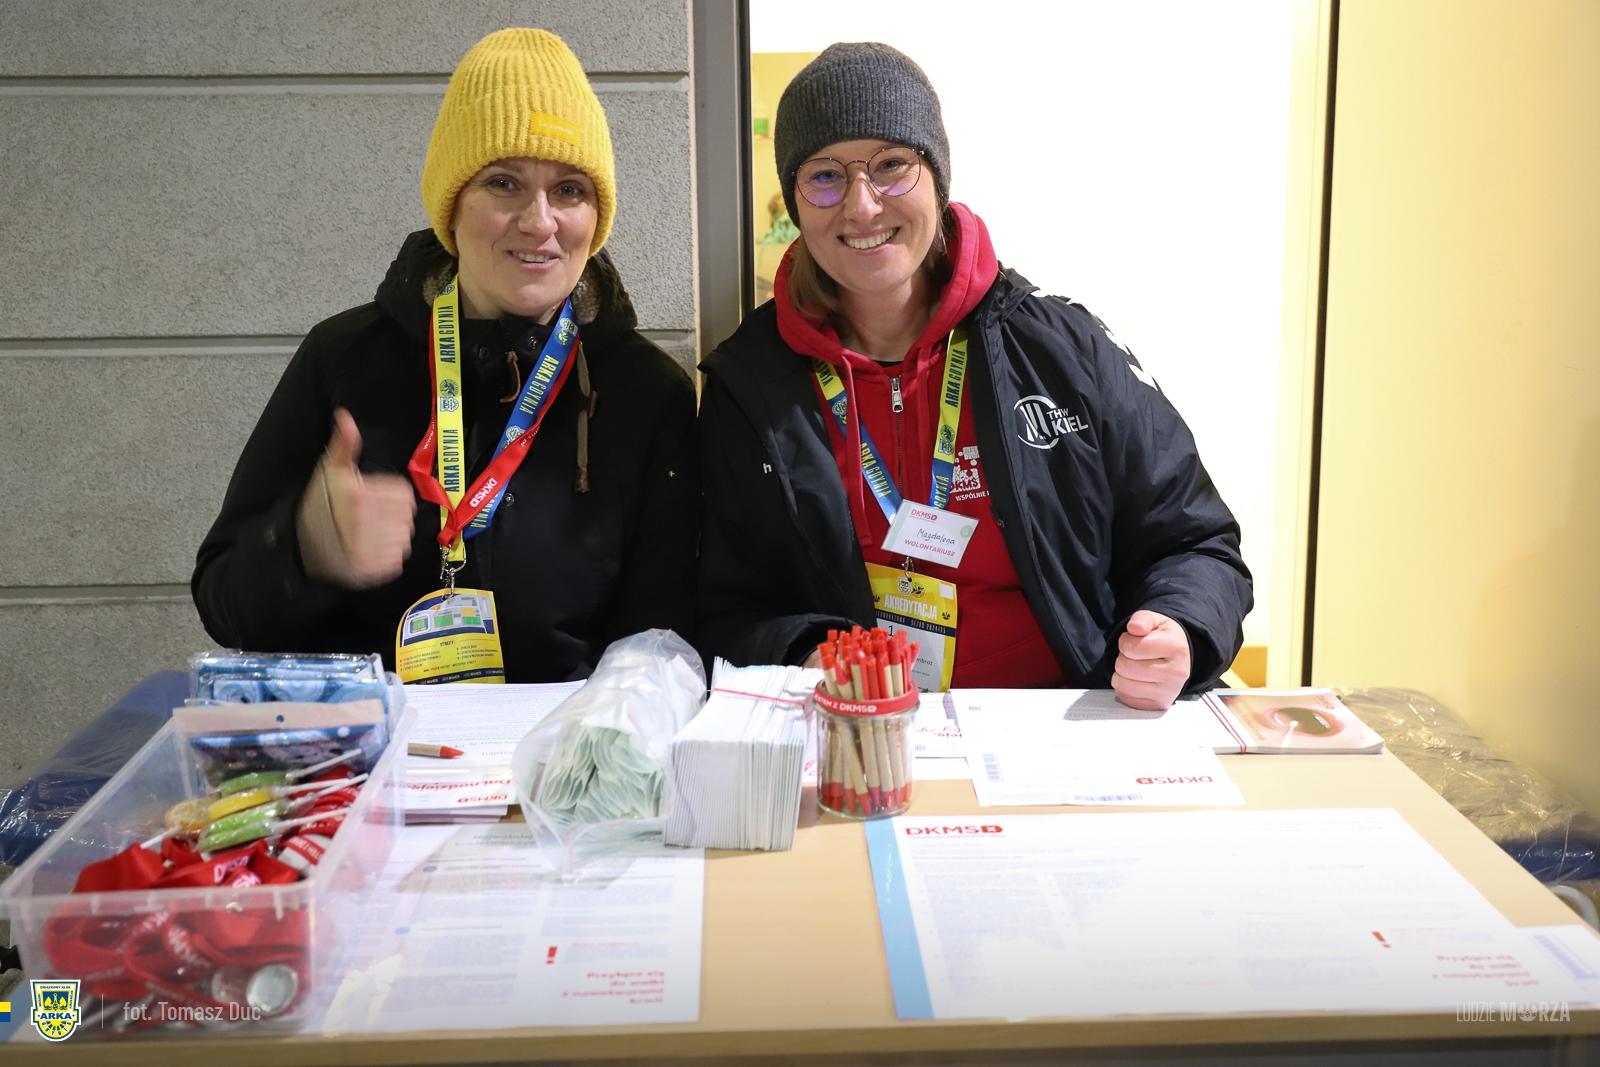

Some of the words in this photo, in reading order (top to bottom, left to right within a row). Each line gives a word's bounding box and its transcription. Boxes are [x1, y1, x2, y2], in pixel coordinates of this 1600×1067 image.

[437, 306, 455, 334] GDYNIA
[439, 336, 456, 363] ARKA
[534, 354, 560, 383] ARKA
[948, 349, 966, 382] GDYNIA
[519, 380, 546, 415] GDYNIA
[945, 380, 961, 408] ARKA
[1046, 408, 1069, 420] THW
[1051, 415, 1089, 436] KIEL
[442, 429, 460, 462] GDYNIA
[860, 442, 877, 468] ARKA
[444, 464, 460, 492] ARKA
[865, 466, 892, 498] GDYNIA
[956, 490, 986, 501] WSPÓLNIE
[904, 539, 956, 556] WOLONTARIUSZ
[884, 594, 938, 620] AKREDYTACJA
[888, 625, 894, 636] 1
[840, 702, 868, 713] DKMS
[906, 826, 982, 836] DKMS
